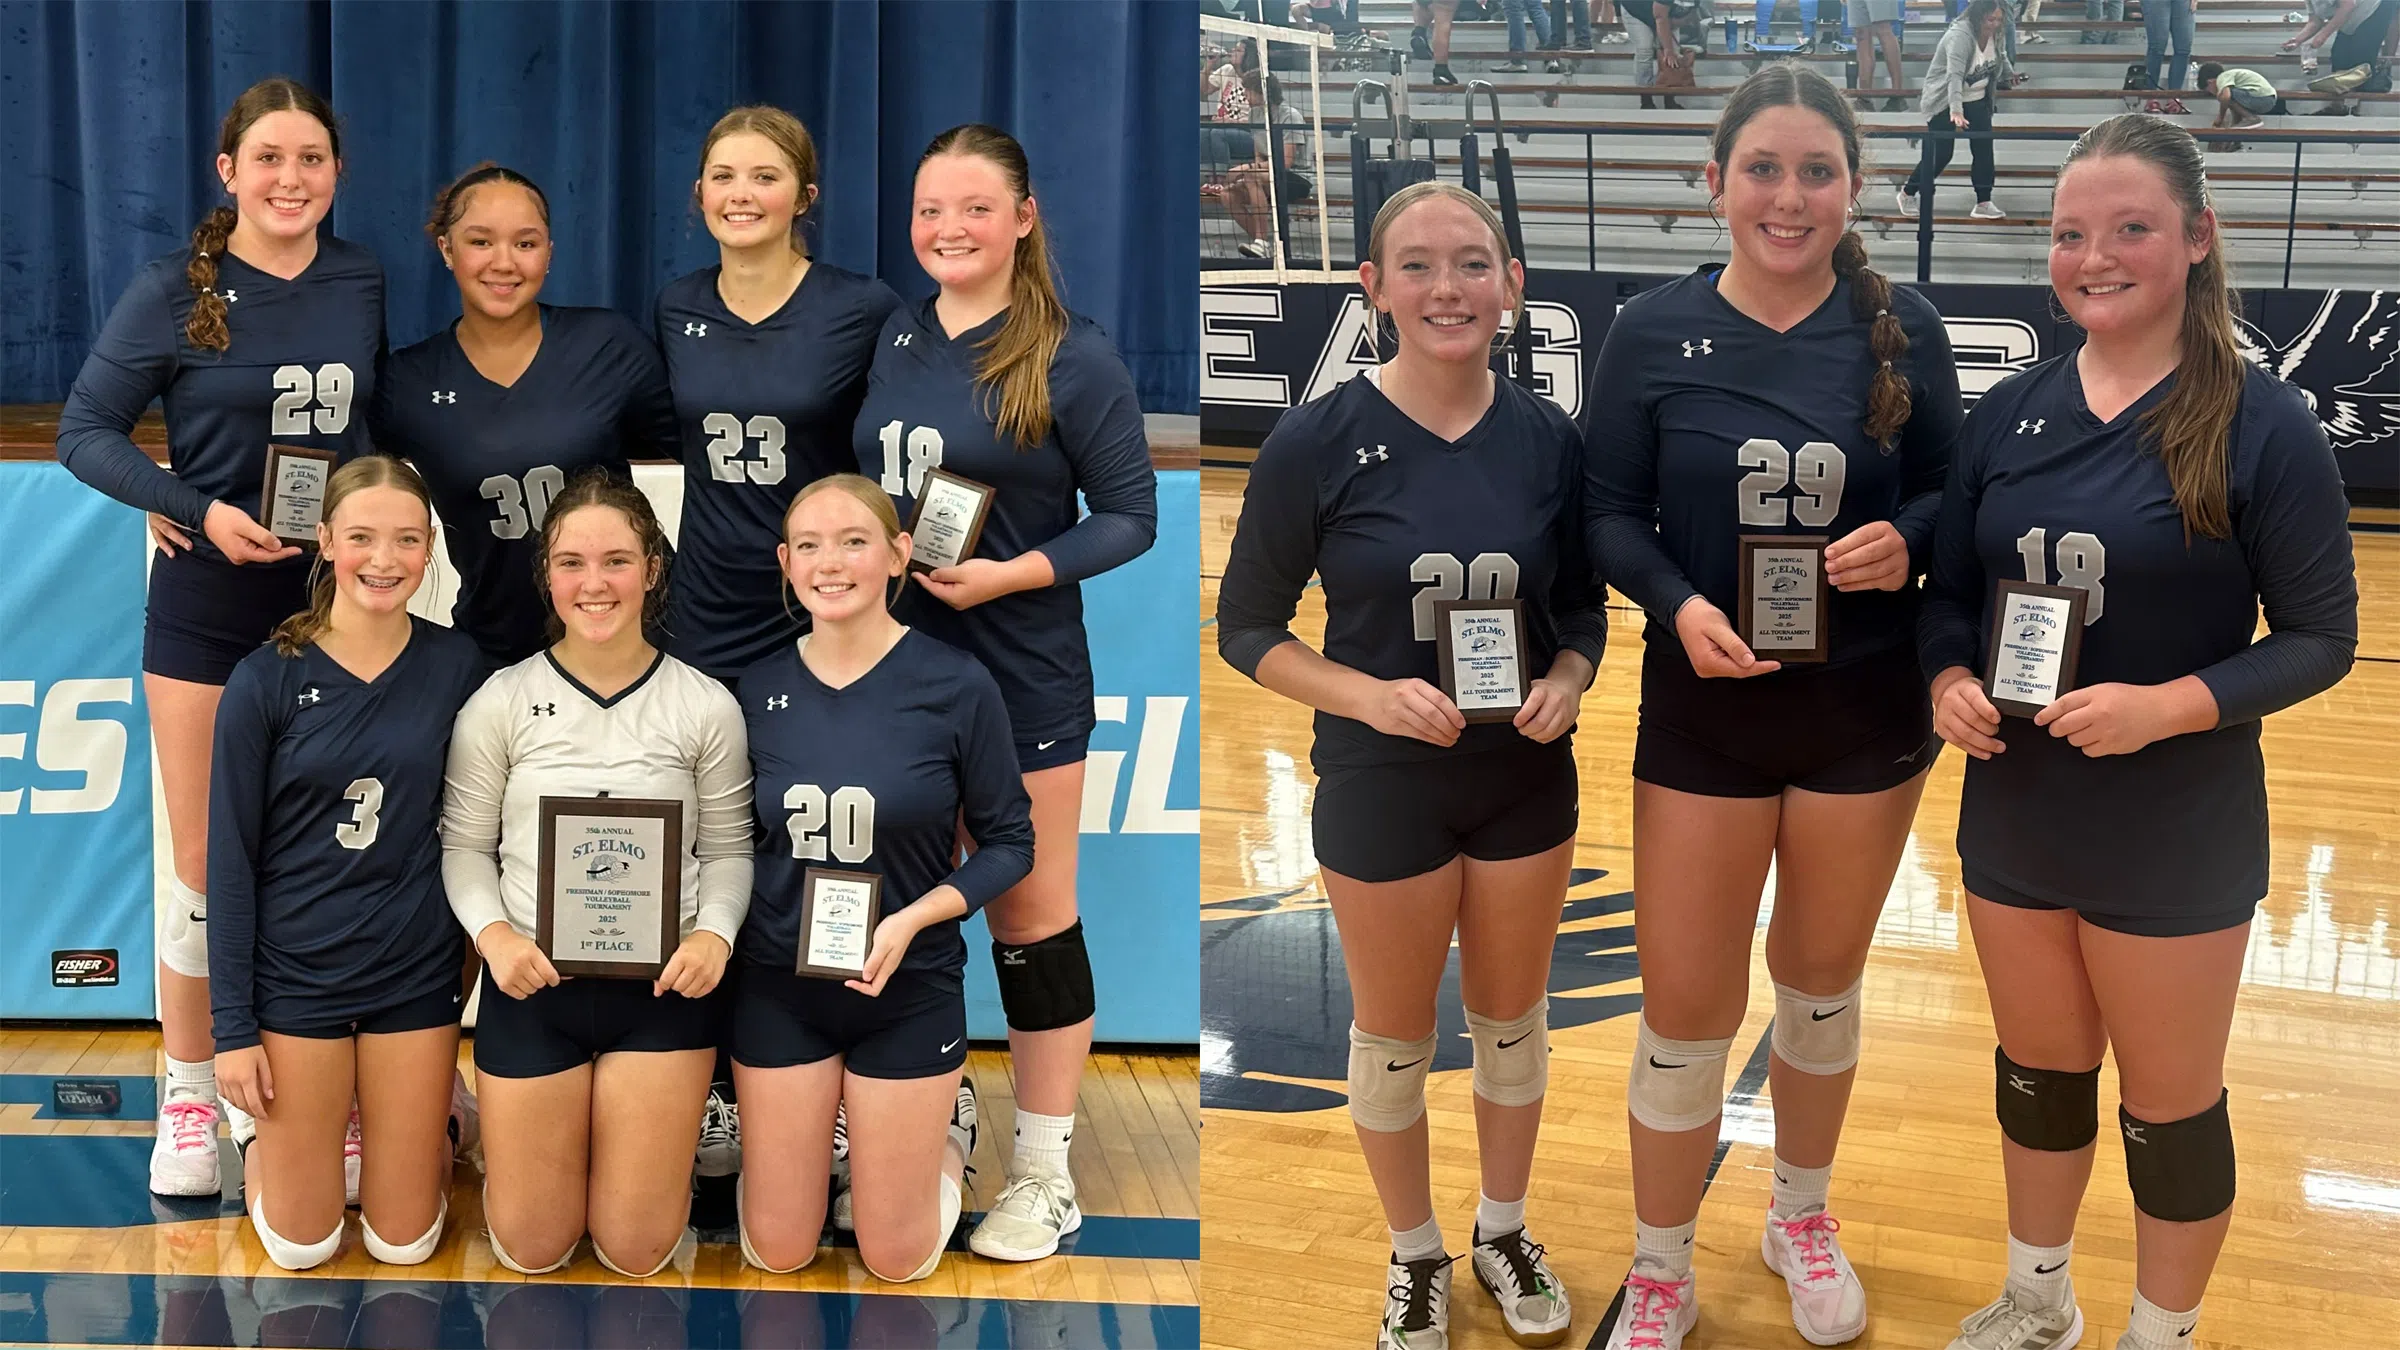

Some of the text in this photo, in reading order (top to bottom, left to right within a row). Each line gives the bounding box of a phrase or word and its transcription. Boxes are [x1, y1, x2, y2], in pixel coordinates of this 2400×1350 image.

[271, 363, 354, 436] 29
[702, 412, 787, 485] 23
[879, 419, 944, 500] 18
[297, 470, 319, 482] ELMO
[1738, 438, 1846, 526] 29
[479, 464, 565, 540] 30
[946, 498, 968, 514] ELMO
[1764, 566, 1808, 578] ST. ELMO
[2017, 527, 2106, 626] 18
[2013, 612, 2056, 629] ST. ELMO
[1462, 626, 1506, 639] ST. ELMO
[2012, 680, 2052, 690] TOURNAMENT
[2016, 686, 2033, 694] TEAM
[335, 777, 385, 850] 3
[783, 784, 876, 863] 20
[585, 827, 634, 836] 35th ANNUAL
[572, 839, 646, 860] ST. ELMO
[566, 888, 603, 896] FRESHMAN
[584, 903, 632, 911] TOURNAMENT
[822, 894, 860, 907] ST. ELMO
[580, 941, 634, 951] 1ST PLACE
[56, 960, 103, 970] FISHER
